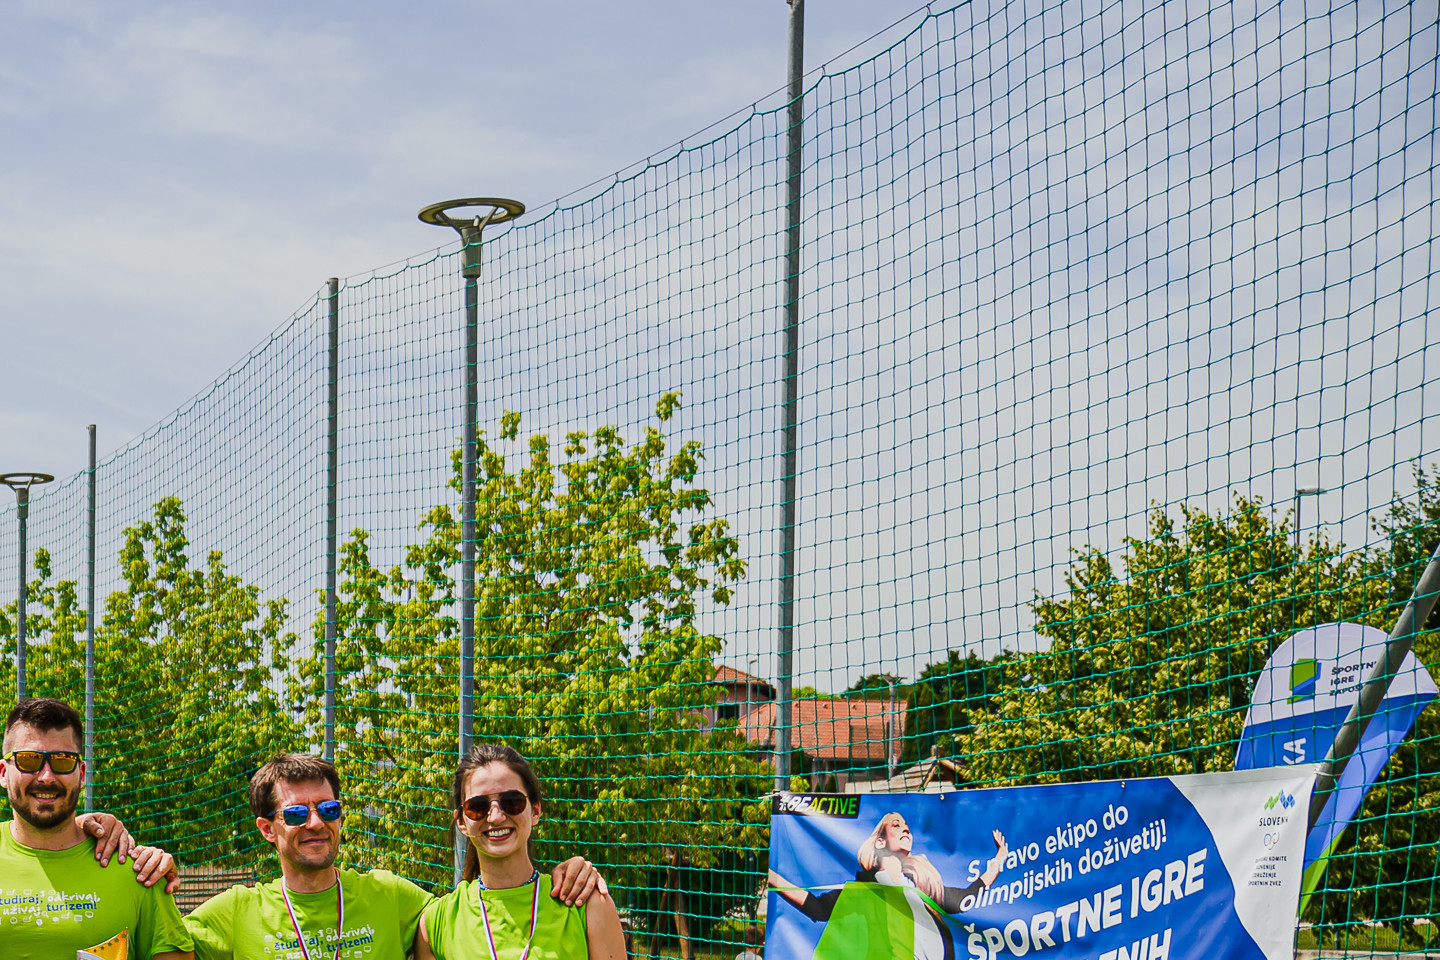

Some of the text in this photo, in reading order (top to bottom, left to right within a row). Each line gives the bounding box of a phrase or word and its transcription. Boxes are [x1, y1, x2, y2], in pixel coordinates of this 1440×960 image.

[1331, 661, 1376, 676] ŠPORTN
[1330, 675, 1355, 686] IGRE
[1329, 684, 1364, 696] ZAPOS
[966, 859, 980, 882] S
[1045, 818, 1098, 854] ekipo
[1102, 804, 1129, 831] do
[959, 818, 1167, 912] olimpijskih doživetij!
[1130, 848, 1208, 919] IGRE
[274, 935, 323, 951] študraj,
